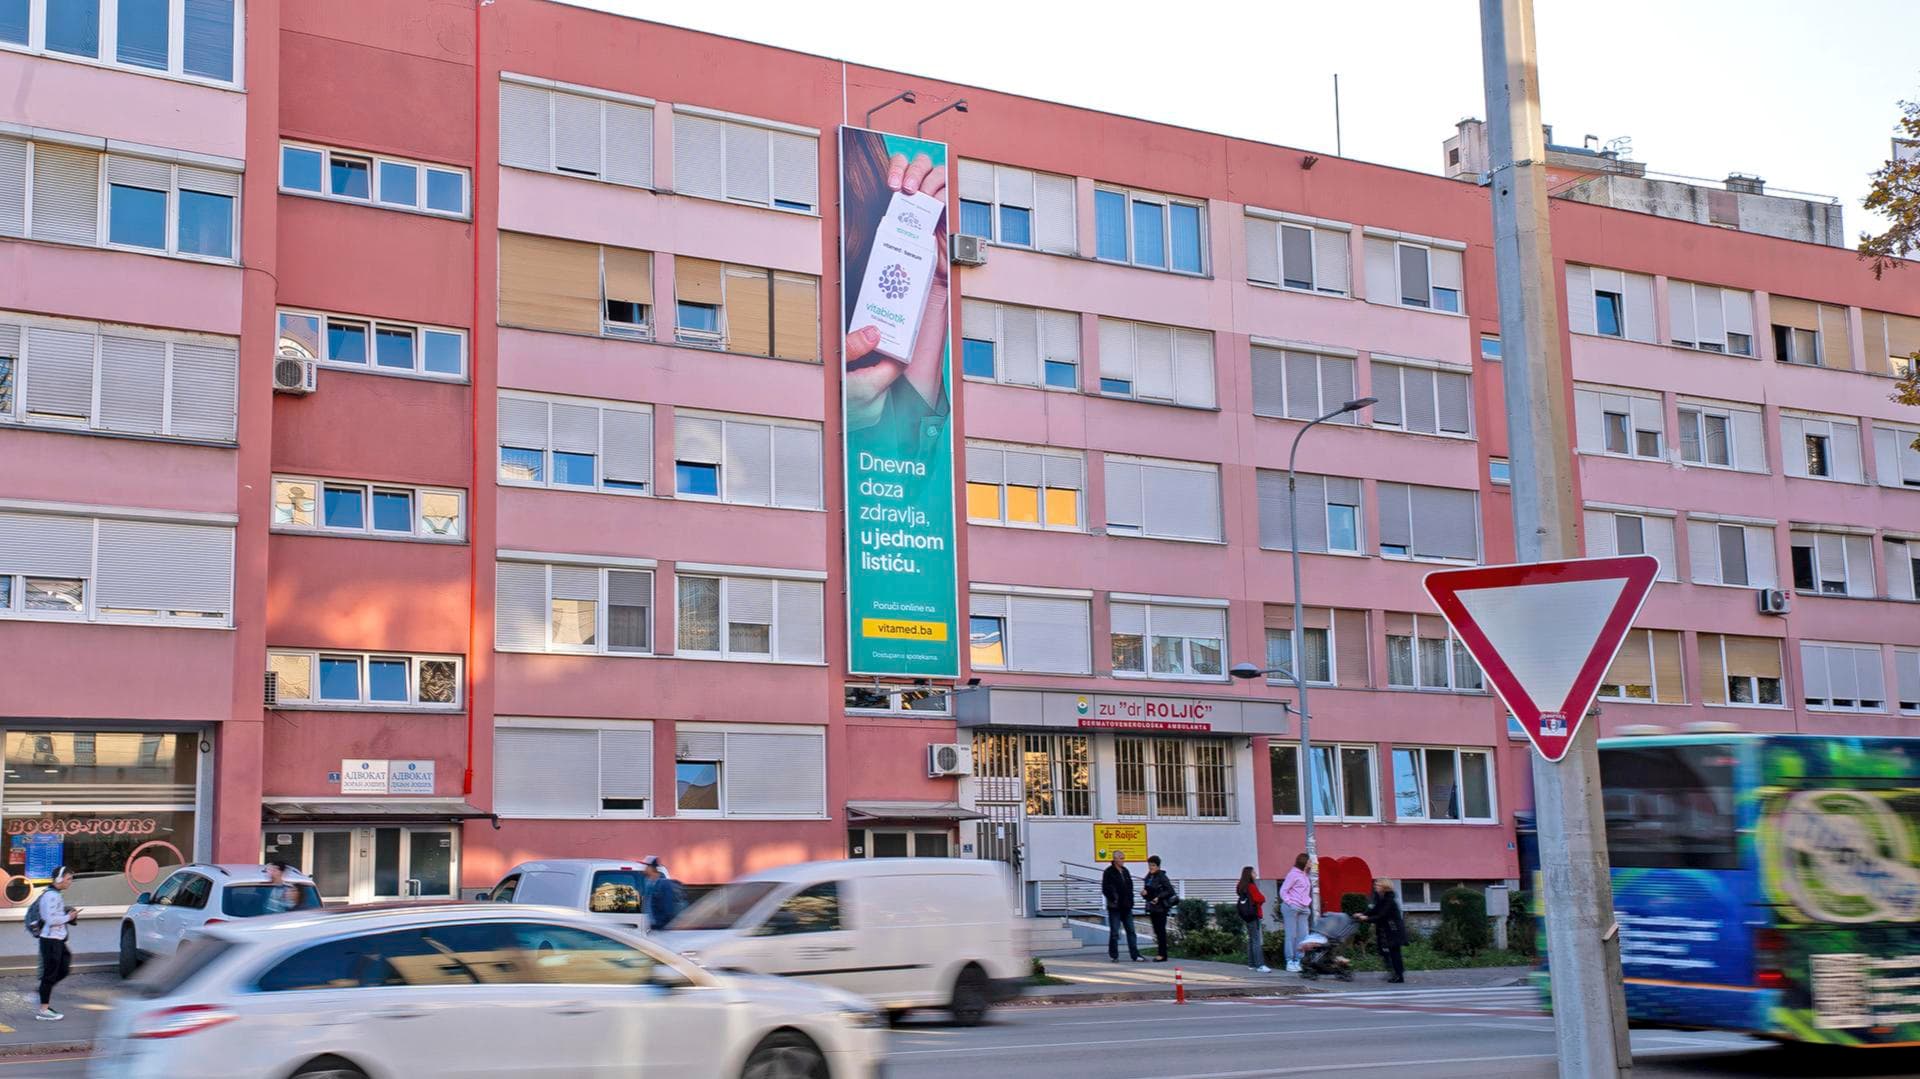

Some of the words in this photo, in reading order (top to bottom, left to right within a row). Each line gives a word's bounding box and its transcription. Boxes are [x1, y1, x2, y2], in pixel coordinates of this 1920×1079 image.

[860, 452, 926, 476] Dnevna
[860, 478, 904, 499] doza
[860, 503, 931, 529] zdravlja,
[861, 531, 872, 545] u
[873, 528, 944, 551] jednom
[861, 551, 921, 574] listiću.
[900, 603, 924, 613] online
[878, 624, 933, 636] vitamed.ba
[1099, 704, 1116, 716] zu
[344, 771, 386, 780] АДВОКАТ
[392, 771, 433, 780] АДВОКАТ
